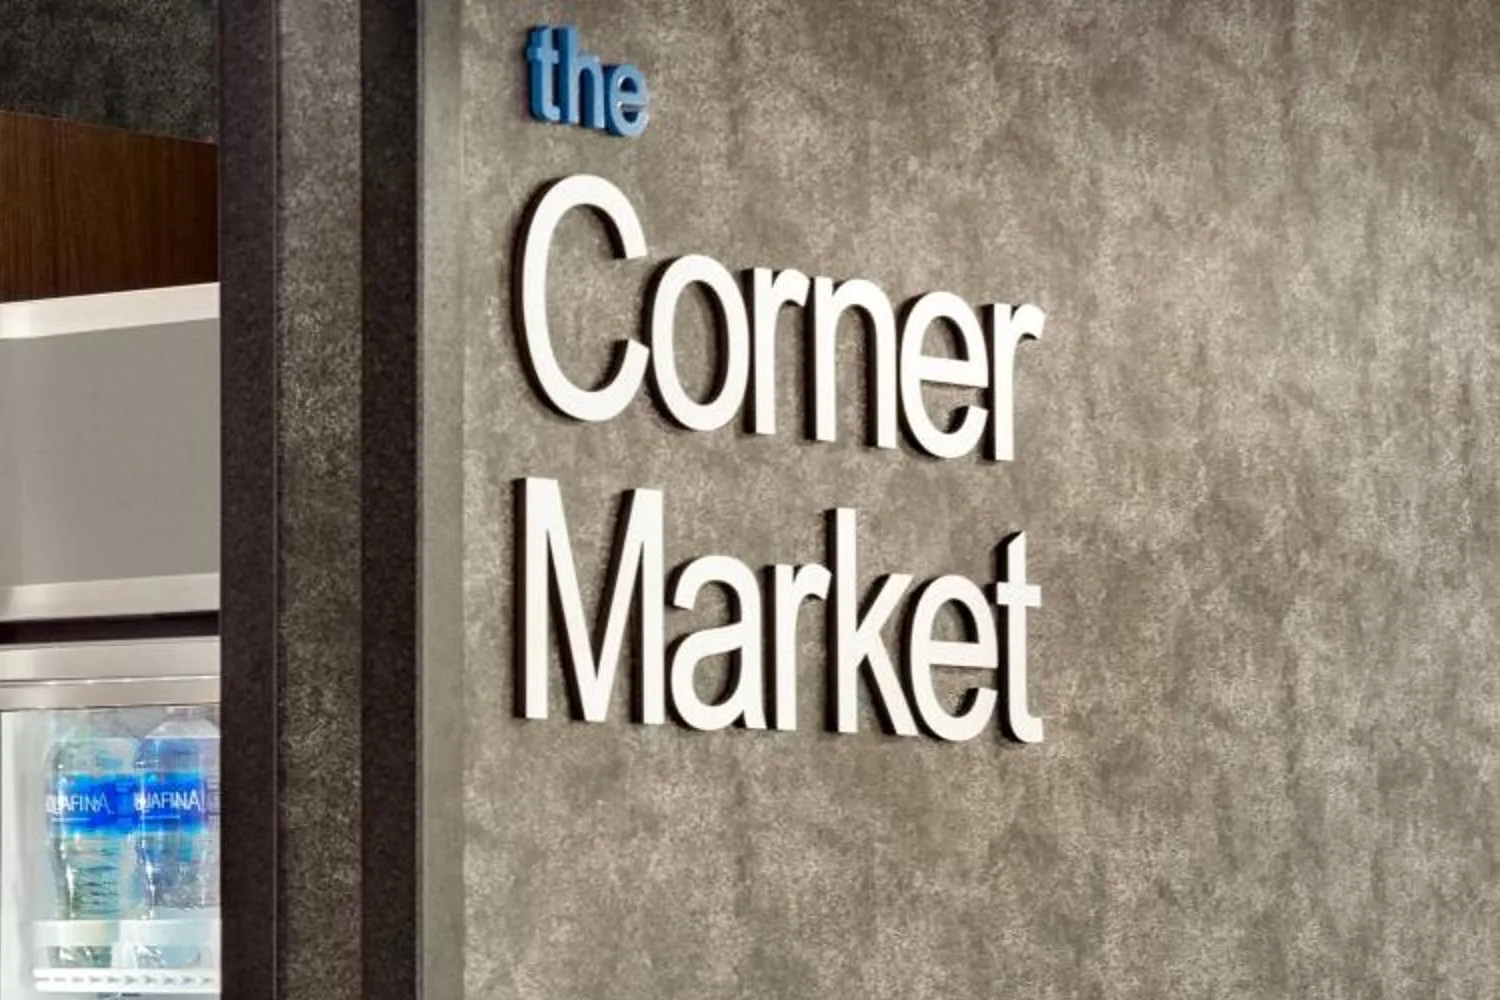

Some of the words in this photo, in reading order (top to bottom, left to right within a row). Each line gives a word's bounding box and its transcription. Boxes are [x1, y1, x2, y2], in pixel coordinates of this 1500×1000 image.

[525, 24, 649, 137] the
[518, 173, 1046, 462] Corner
[520, 476, 1045, 744] Market
